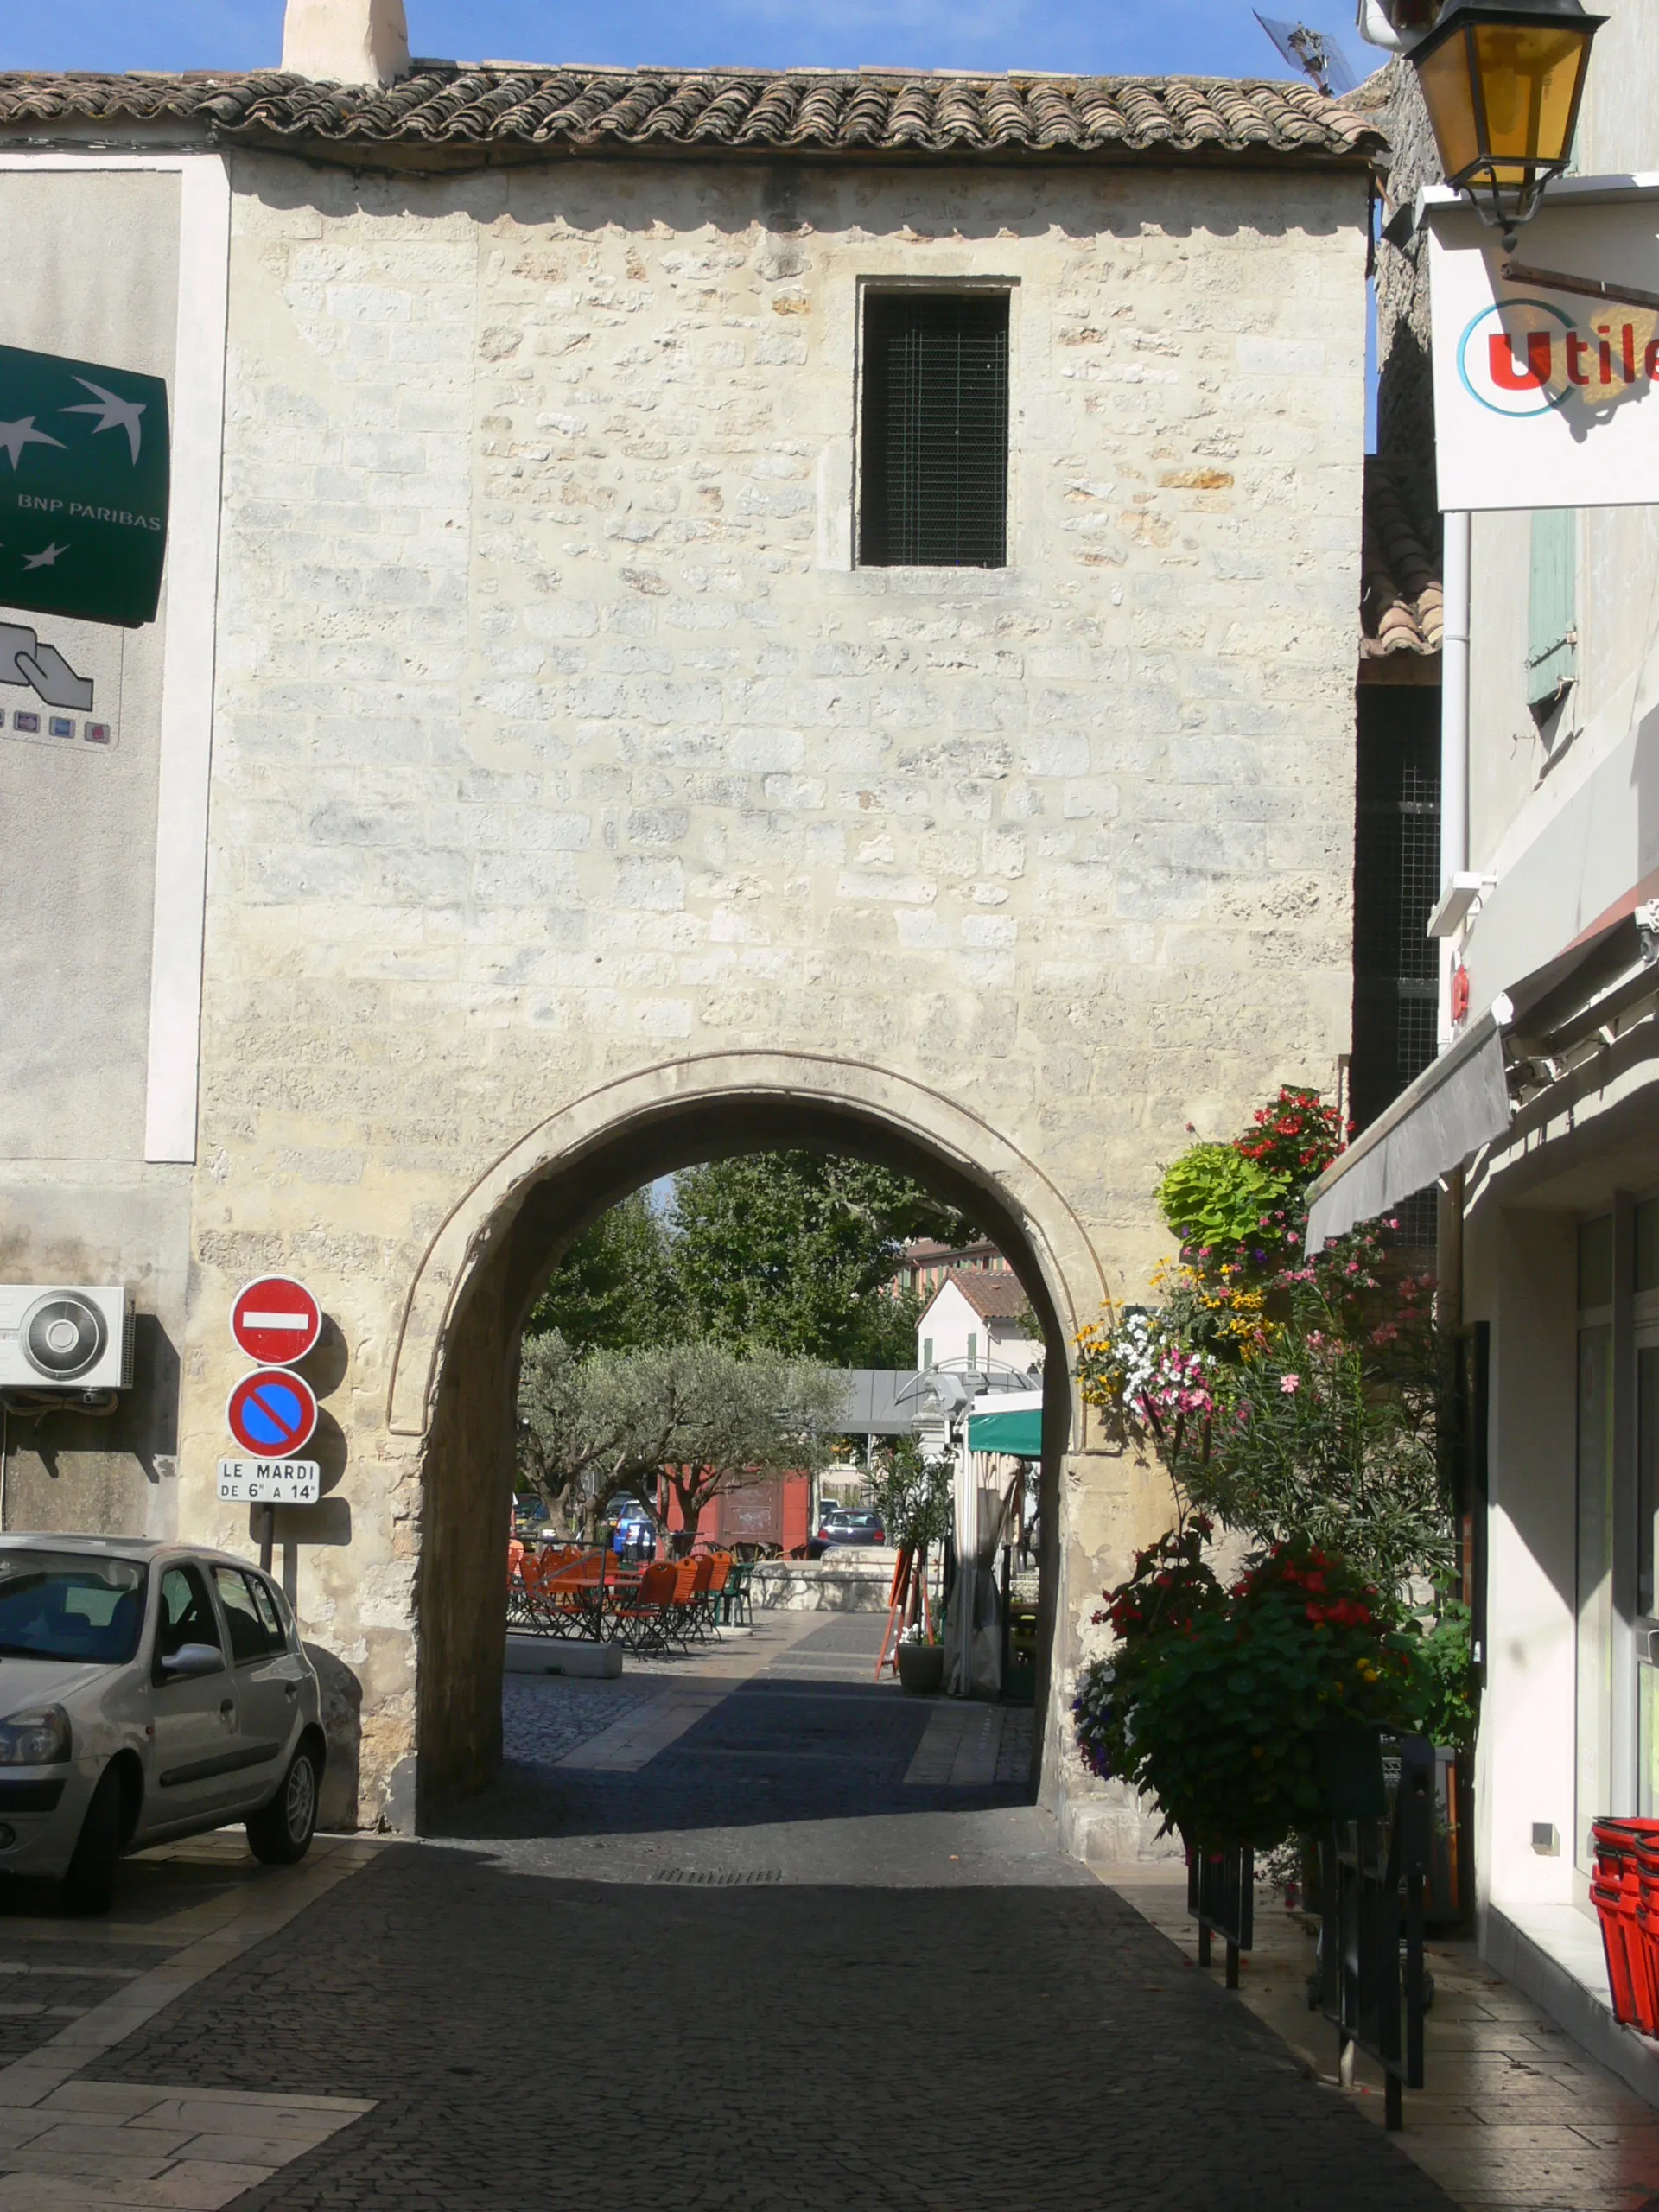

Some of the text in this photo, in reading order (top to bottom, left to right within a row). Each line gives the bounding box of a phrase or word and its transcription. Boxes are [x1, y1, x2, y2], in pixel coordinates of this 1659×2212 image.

[18, 493, 162, 531] BNP PARIBAS
[223, 1463, 314, 1480] LE MARDI
[221, 1484, 238, 1497] DE
[273, 1486, 281, 1498] A
